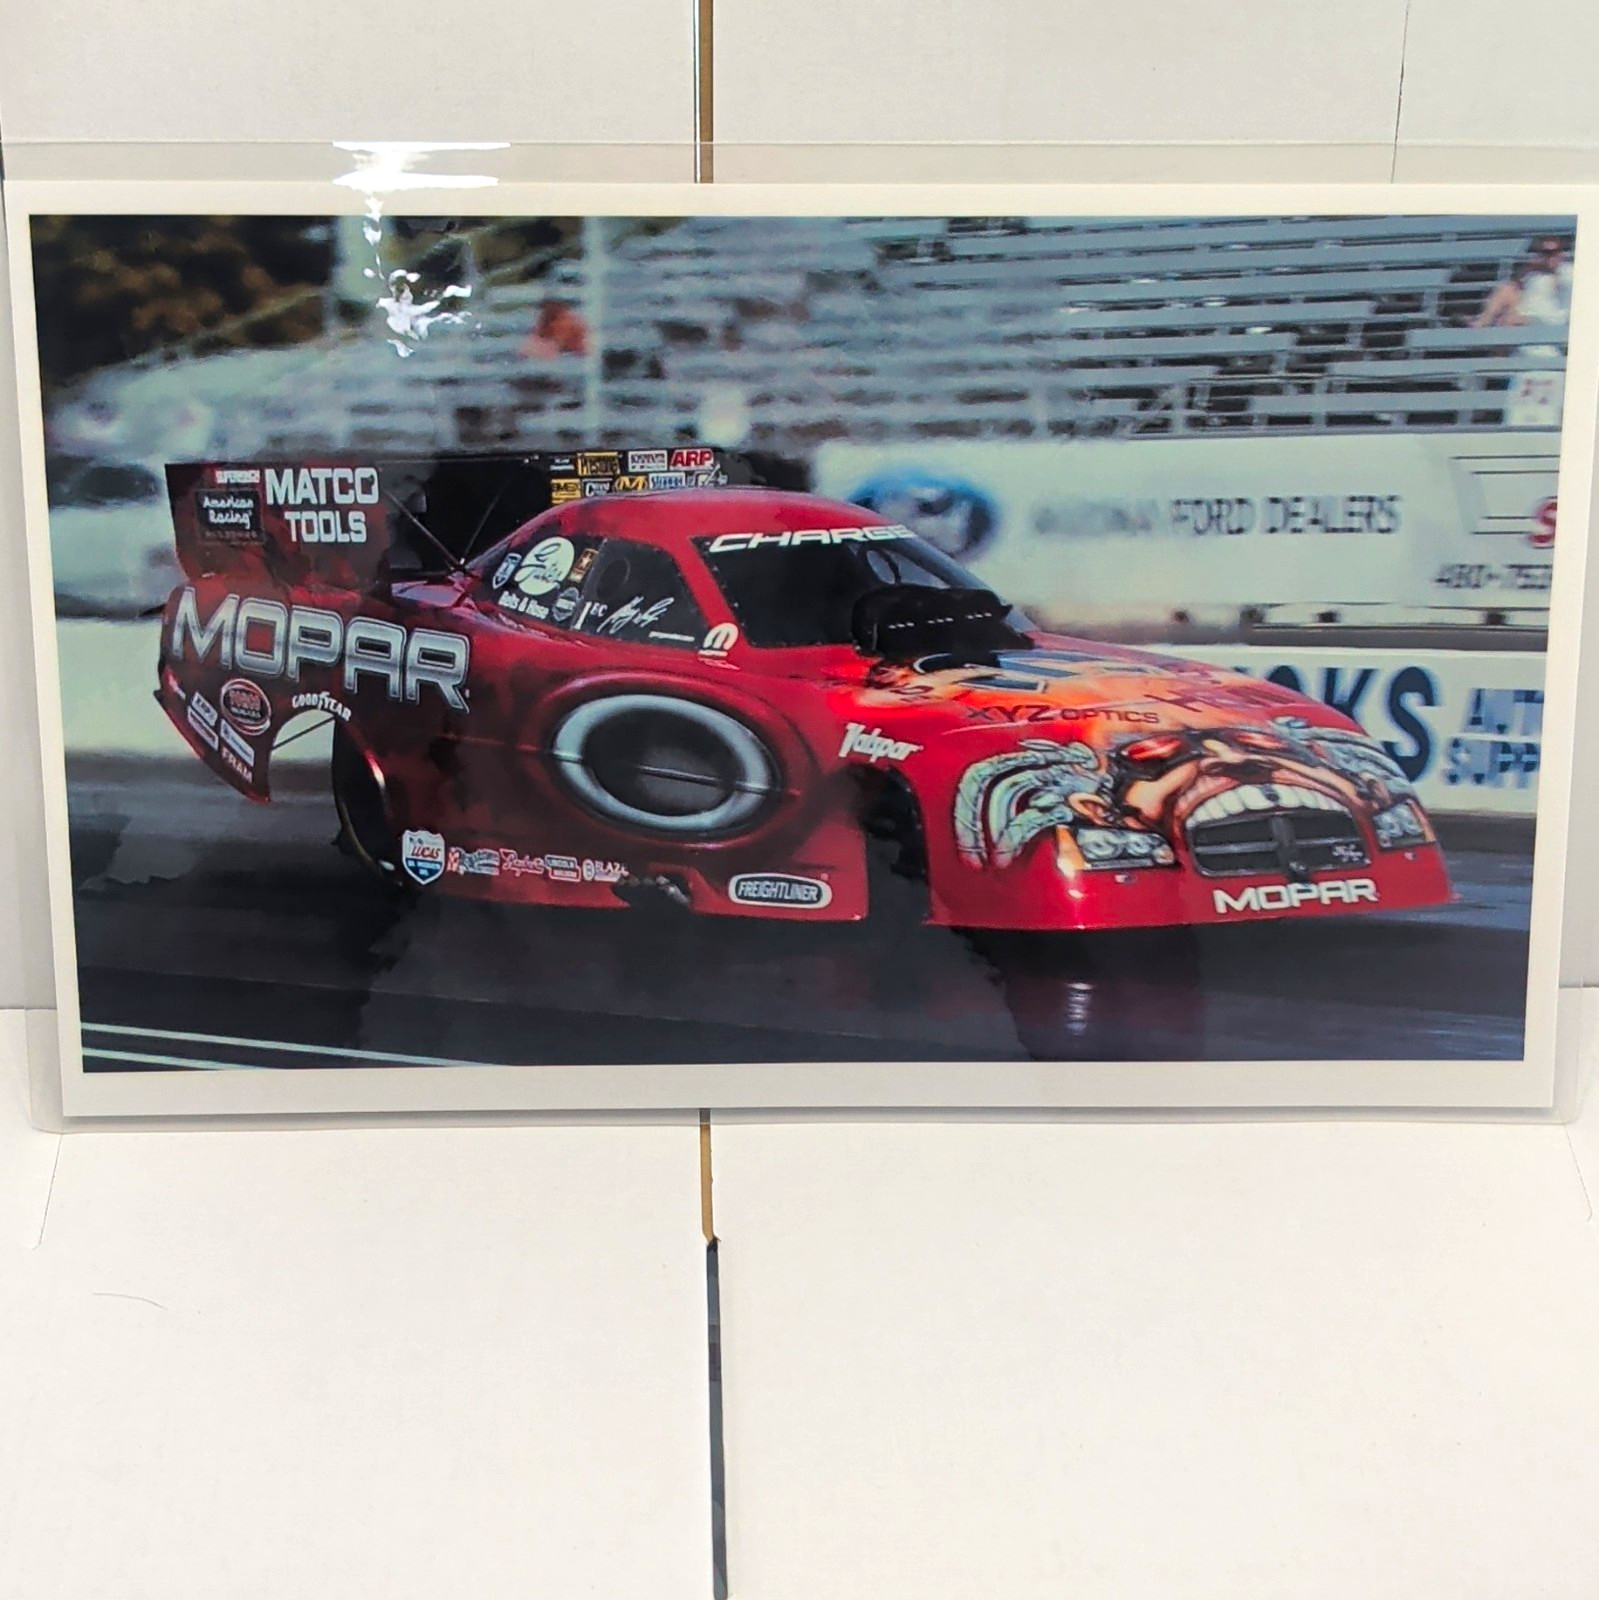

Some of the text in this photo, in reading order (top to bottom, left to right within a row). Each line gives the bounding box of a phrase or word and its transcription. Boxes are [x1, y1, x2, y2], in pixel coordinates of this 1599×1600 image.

[671, 450, 713, 467] ARP
[264, 467, 379, 505] MATCO
[284, 511, 367, 543] TOOLS
[1171, 496, 1258, 536] FORD
[1266, 493, 1401, 536] DEALERS
[171, 585, 471, 714] MOPAR
[966, 704, 1160, 725] XYZ OPTICS
[411, 845, 441, 859] LUCAS
[738, 880, 819, 901] FREIGHTLINER
[1212, 878, 1379, 914] MOPAR
